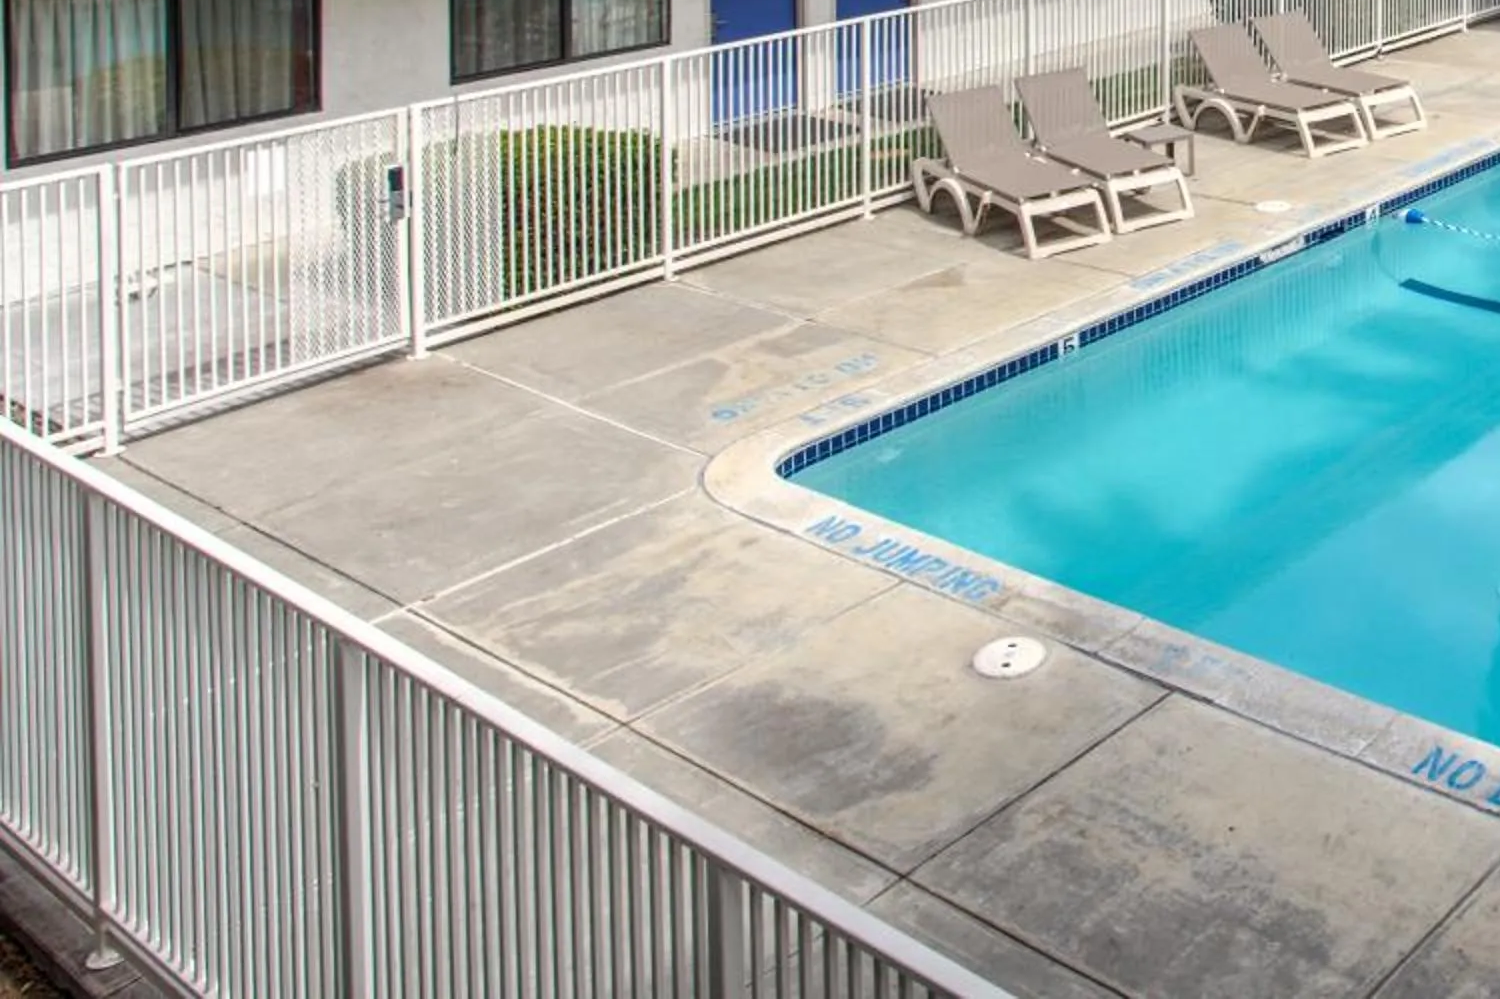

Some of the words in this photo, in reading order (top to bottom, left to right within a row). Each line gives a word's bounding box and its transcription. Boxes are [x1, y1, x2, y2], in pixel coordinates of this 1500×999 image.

[805, 514, 861, 544] NO
[851, 537, 1001, 601] JUMPING
[1412, 746, 1486, 790] NO
